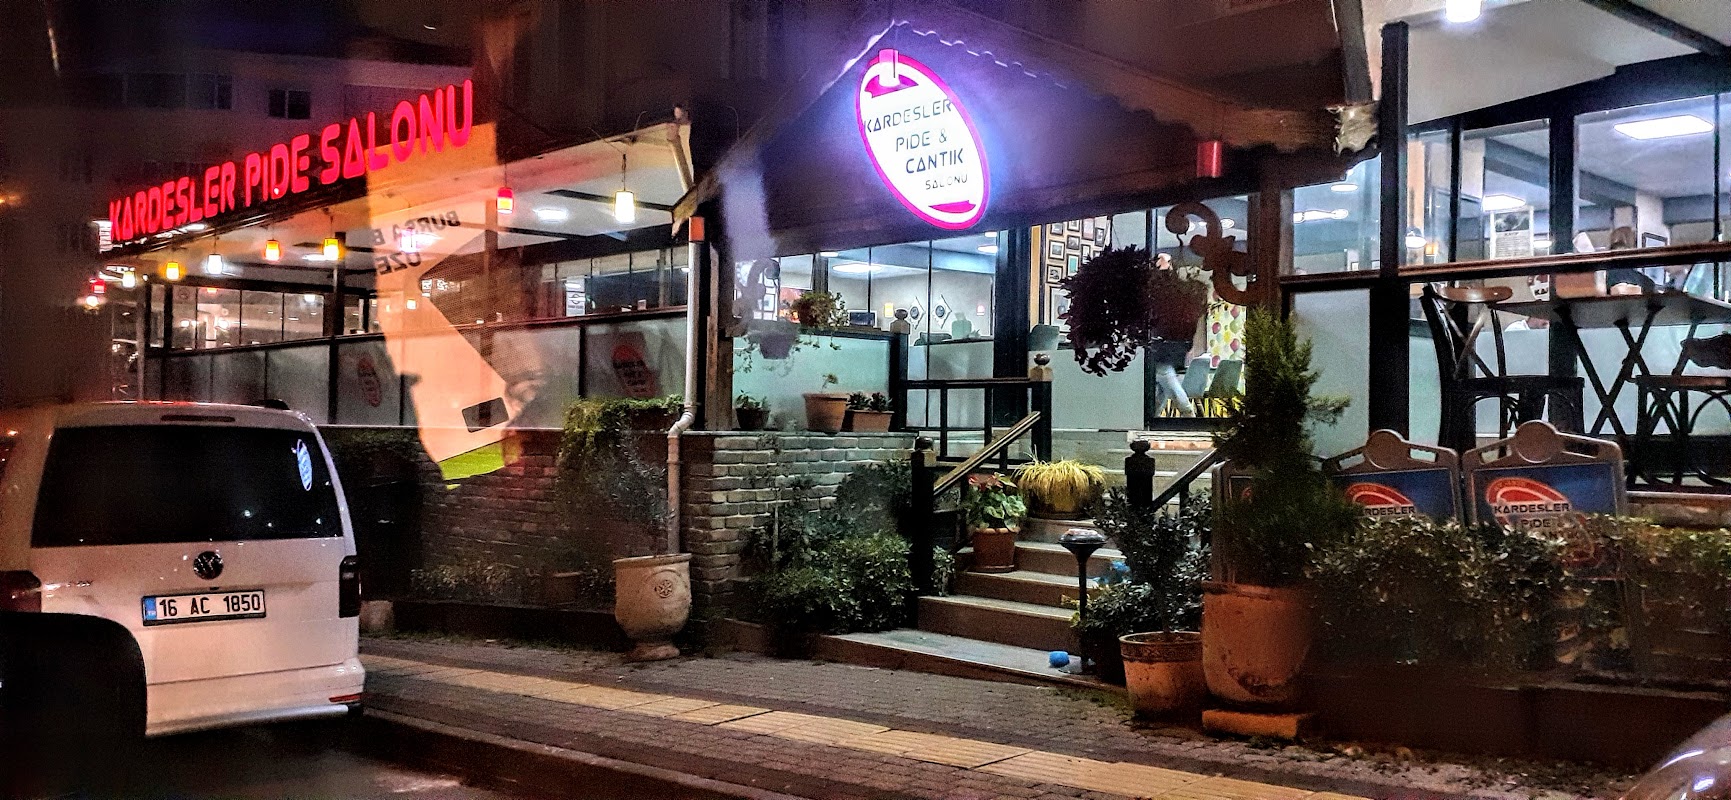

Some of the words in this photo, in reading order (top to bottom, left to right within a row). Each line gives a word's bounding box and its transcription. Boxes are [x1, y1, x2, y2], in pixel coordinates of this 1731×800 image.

[864, 98, 952, 132] KARDESLER
[939, 128, 948, 144] &
[109, 161, 236, 241] KARDESLER
[320, 79, 472, 185] SALONU
[906, 148, 963, 174] CANTIK
[925, 174, 968, 190] SALONU
[1363, 505, 1416, 517] RDESLER
[1494, 502, 1570, 515] KARDESLER
[159, 599, 178, 617] 16
[190, 596, 211, 615] AC
[223, 593, 261, 613] 1850
